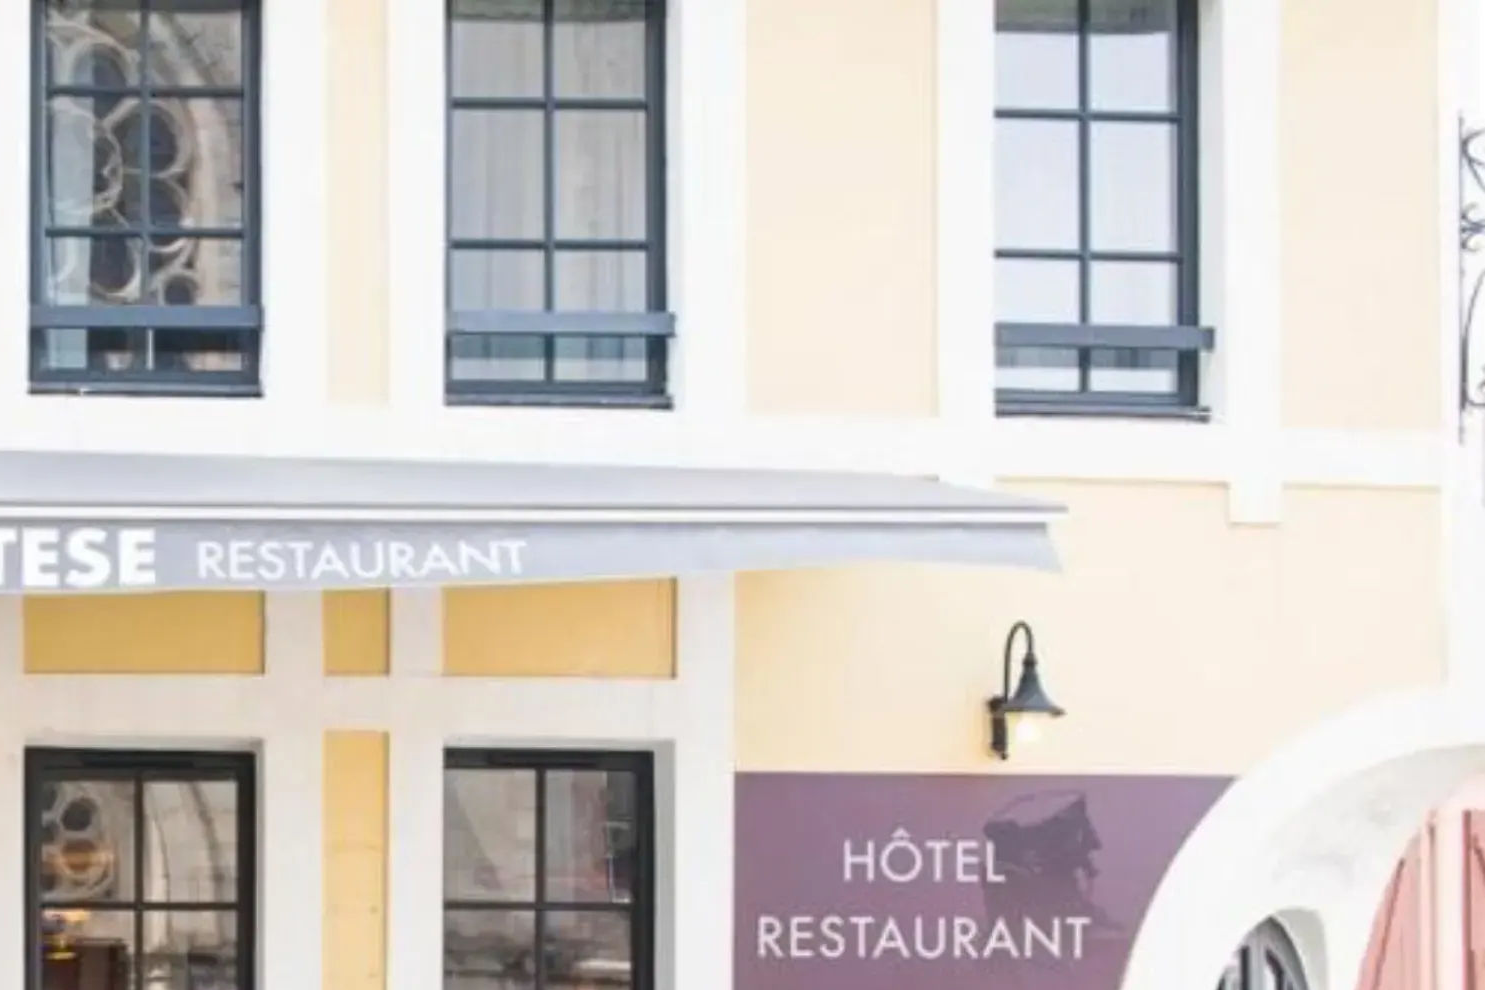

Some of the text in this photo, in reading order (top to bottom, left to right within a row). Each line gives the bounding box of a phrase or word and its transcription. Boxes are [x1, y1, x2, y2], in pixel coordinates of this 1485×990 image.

[197, 539, 528, 580] RESTAURANT
[843, 827, 1006, 883] HÔTEL
[756, 915, 1093, 960] RESTAURANT
